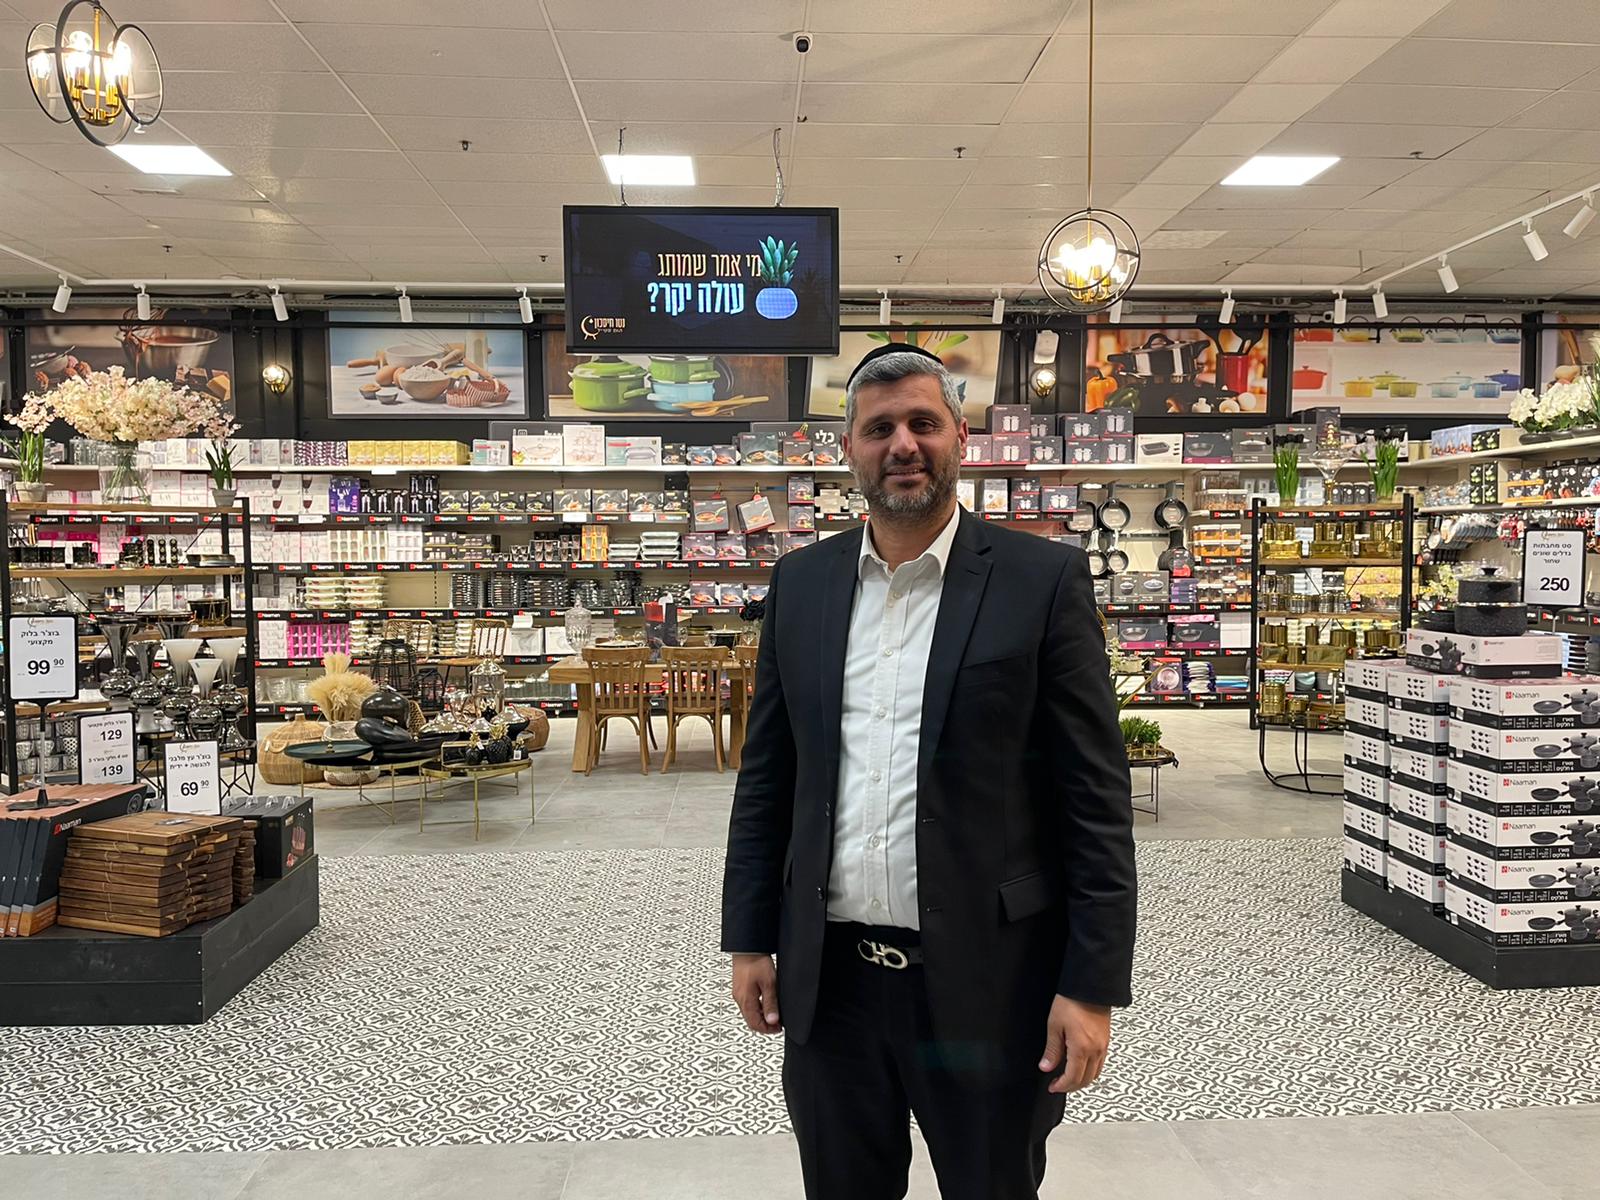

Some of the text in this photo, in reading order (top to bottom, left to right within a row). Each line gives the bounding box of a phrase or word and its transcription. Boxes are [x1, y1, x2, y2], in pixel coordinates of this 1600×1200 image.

[657, 253, 761, 277] מי אמר שמותג
[647, 281, 744, 316] עולה יקר?
[1540, 577, 1570, 591] 250
[21, 630, 38, 638] בלוק
[27, 658, 64, 675] 99 90
[100, 729, 122, 741] 129
[102, 765, 123, 777] 139
[181, 782, 198, 796] 69
